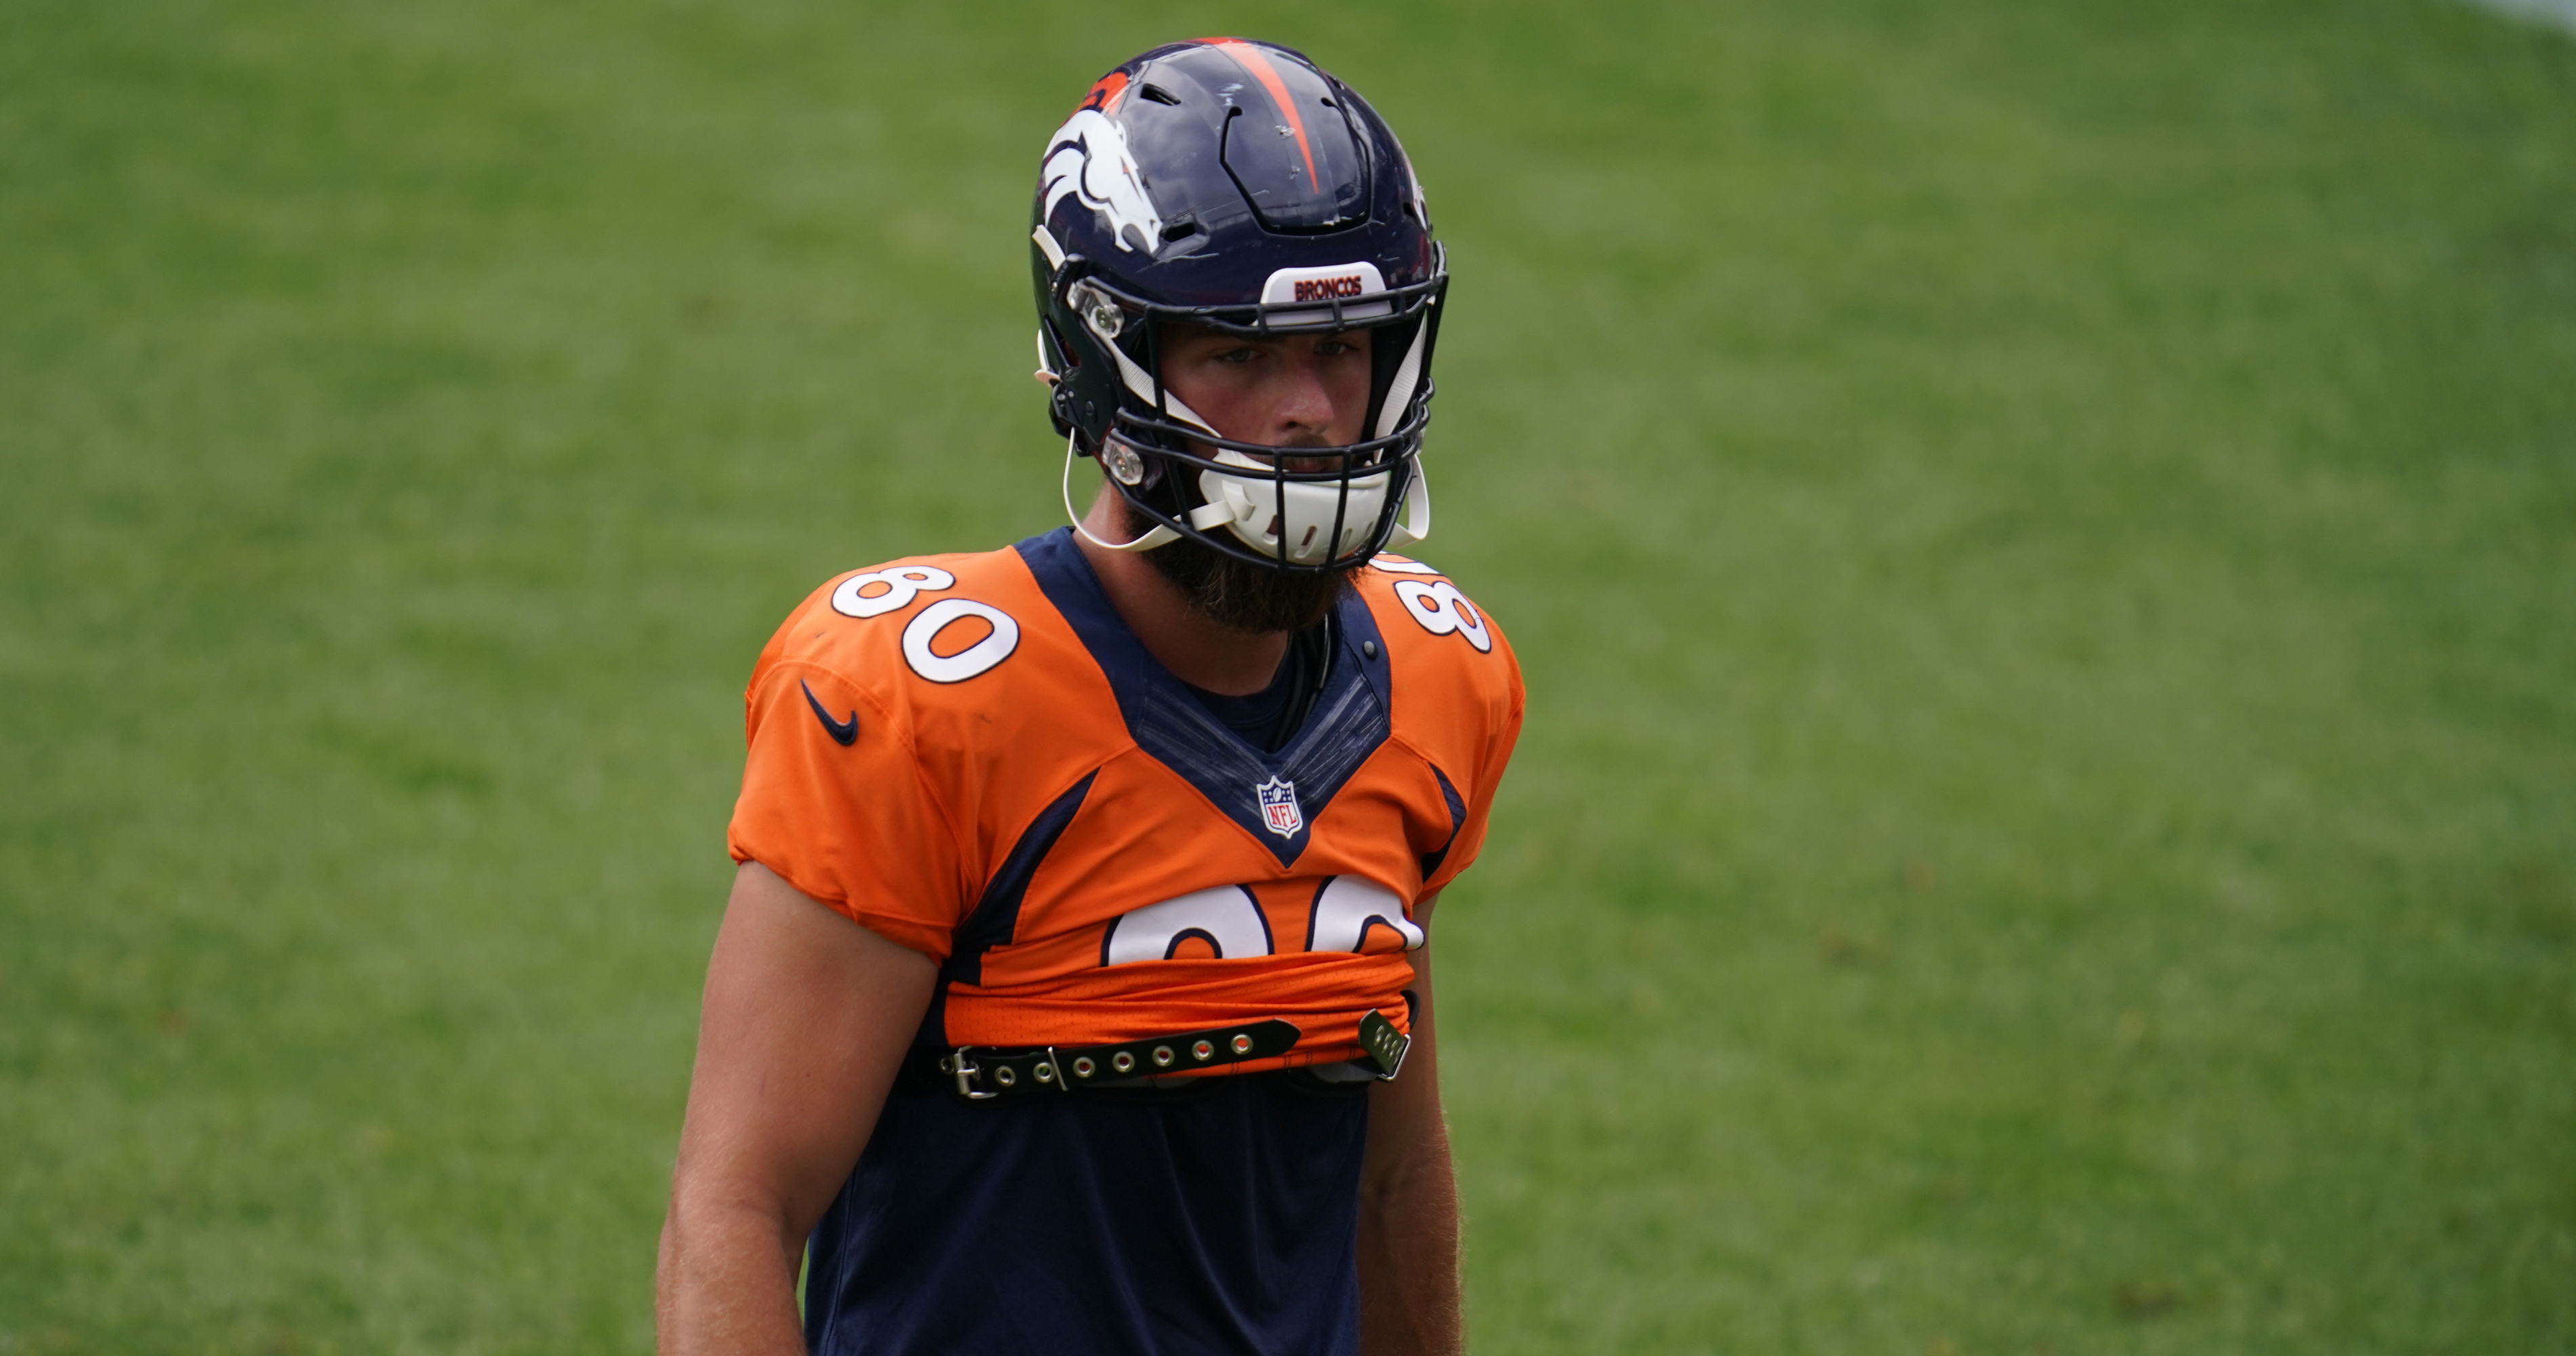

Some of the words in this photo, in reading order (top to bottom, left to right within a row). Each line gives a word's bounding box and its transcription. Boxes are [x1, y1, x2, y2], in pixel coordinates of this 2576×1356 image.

[1295, 275, 1362, 302] BRONCOS
[831, 565, 1020, 683] 80
[1268, 804, 1297, 827] NFL
